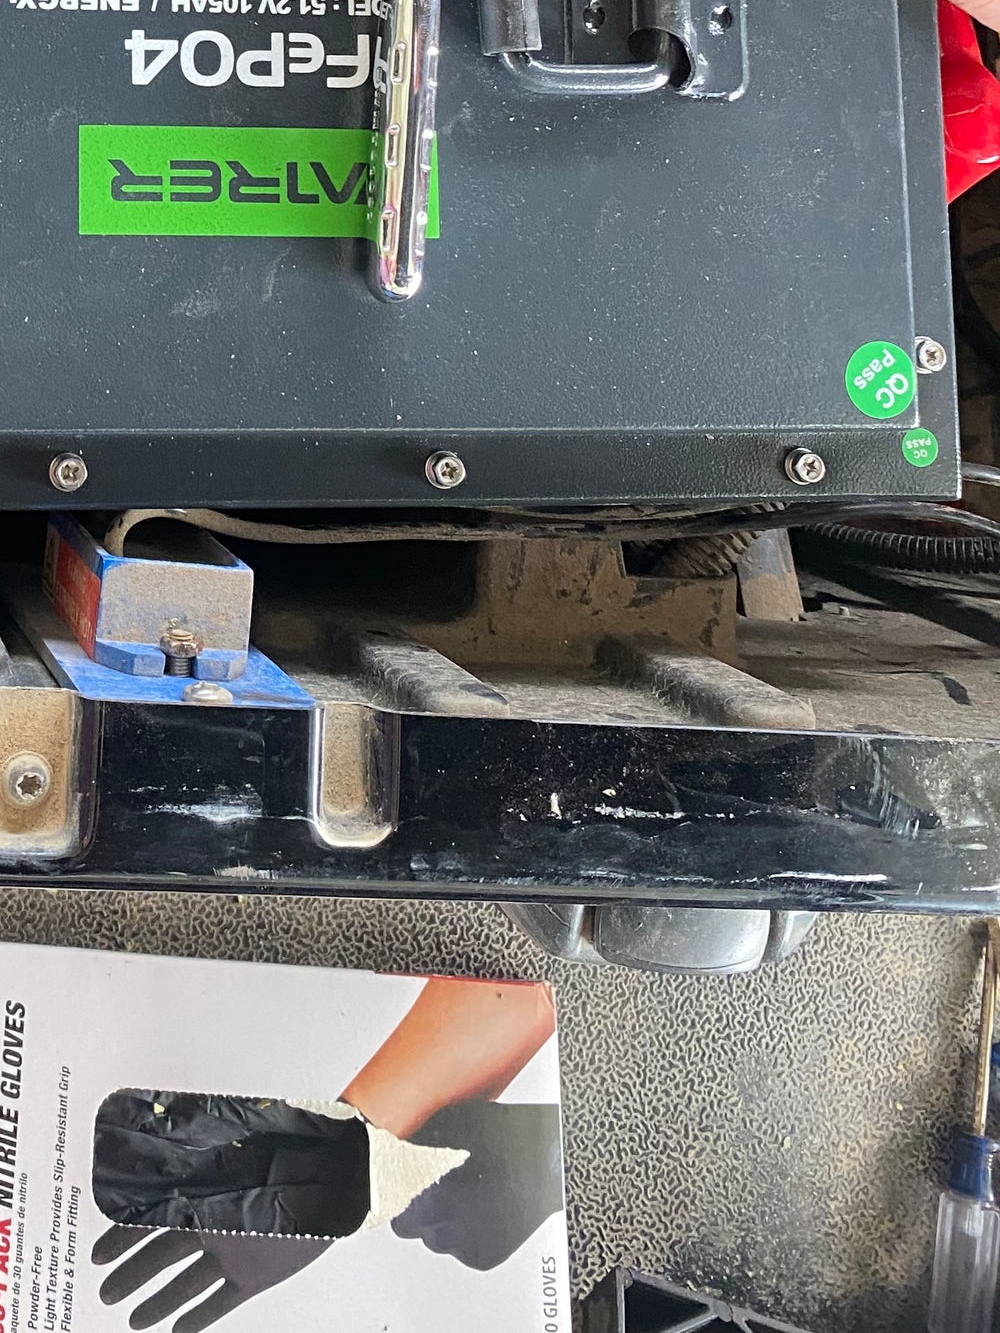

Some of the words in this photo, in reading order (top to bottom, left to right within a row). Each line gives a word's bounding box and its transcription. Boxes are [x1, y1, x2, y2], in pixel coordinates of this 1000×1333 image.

[108, 160, 367, 204] ATRER
[854, 348, 896, 390] Pass
[875, 373, 909, 408] QC
[906, 437, 932, 449] PASS
[912, 449, 928, 459] QC
[0, 1000, 24, 1098] GLOVES
[58, 1066, 70, 1090] Grip
[53, 1094, 67, 1182] Slip-Resistant
[18, 1172, 27, 1203] nitrilo
[67, 1185, 80, 1226] Fitting
[17, 1206, 25, 1218] de
[49, 1186, 62, 1241] Provides
[15, 1221, 24, 1263] guantes
[65, 1231, 75, 1263] Form
[12, 1282, 20, 1294] de
[13, 1265, 21, 1279] 30
[27, 1246, 42, 1329] Powder-Free
[46, 1245, 58, 1293] Texture
[64, 1268, 73, 1277] &
[542, 1256, 558, 1318] GLOVES
[44, 1297, 56, 1330] Light
[60, 1281, 73, 1332] Flexible
